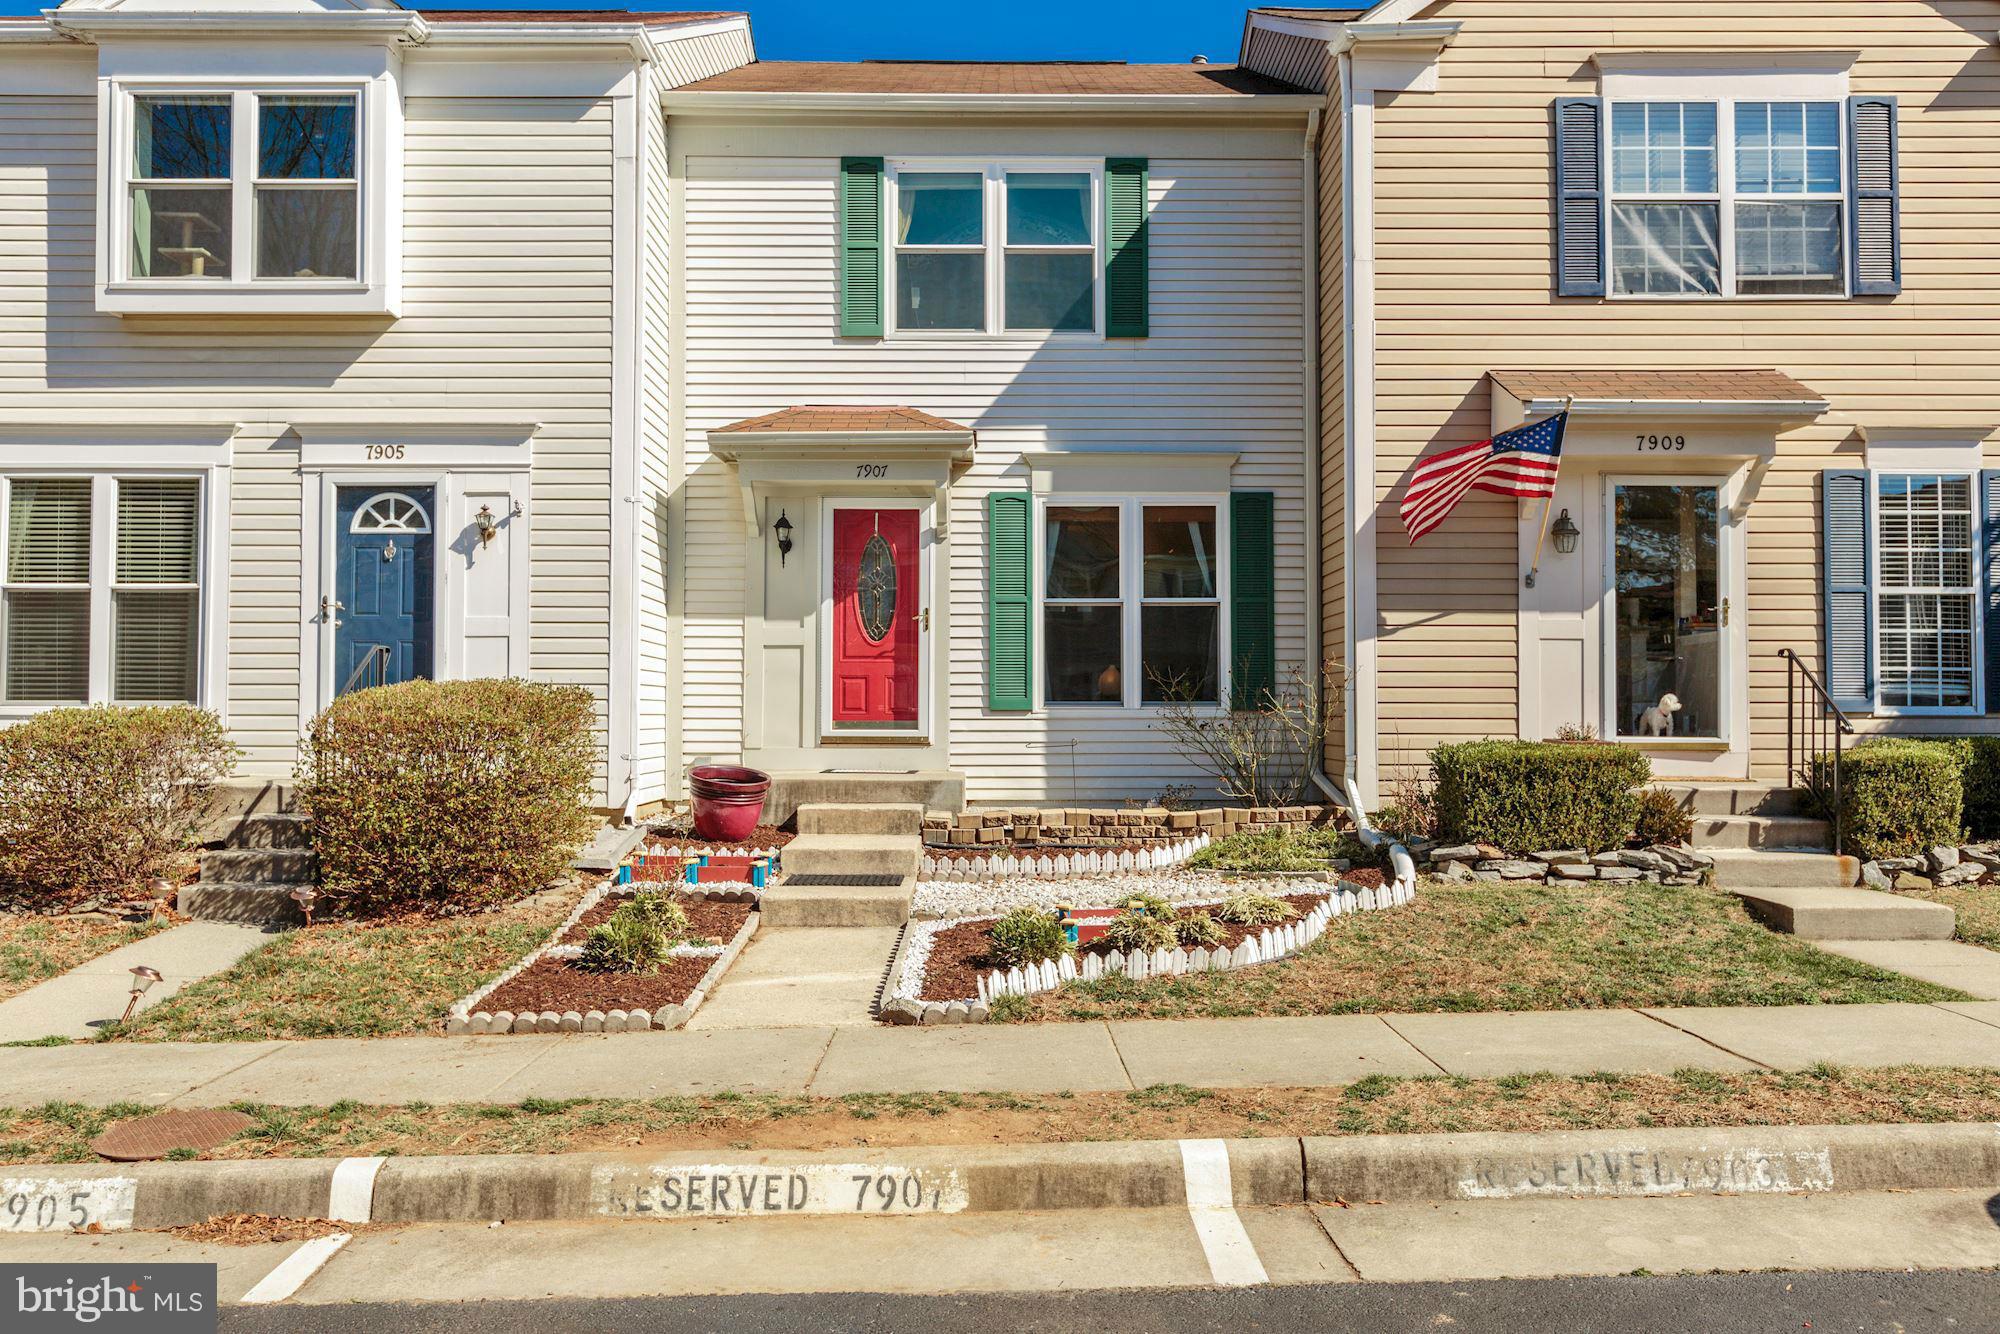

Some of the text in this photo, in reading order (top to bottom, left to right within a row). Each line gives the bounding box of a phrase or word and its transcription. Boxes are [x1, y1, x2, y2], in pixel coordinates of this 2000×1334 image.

[1635, 434, 1685, 451] 7909
[365, 444, 405, 460] 7905
[856, 464, 888, 478] 7907
